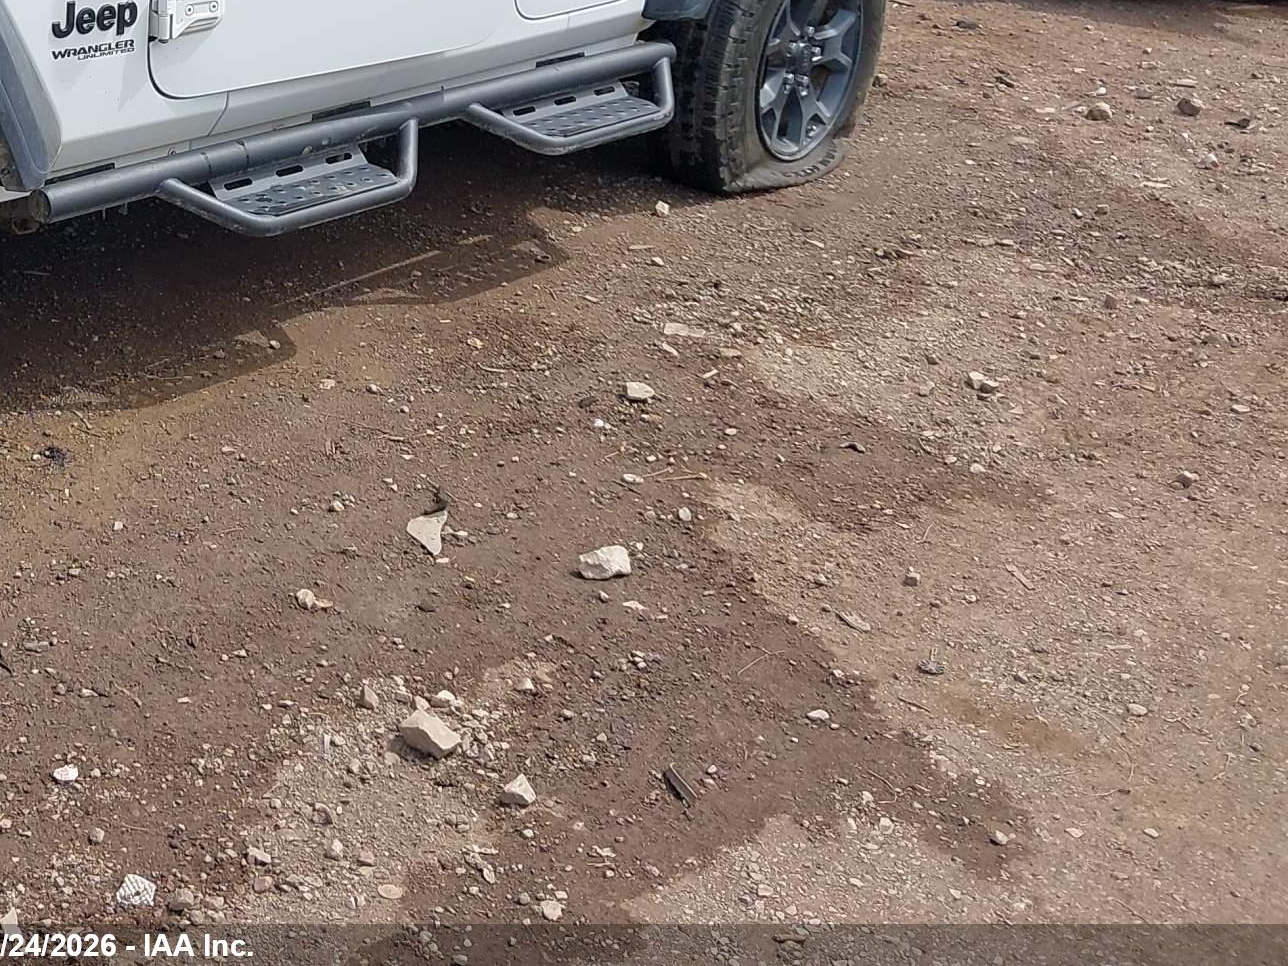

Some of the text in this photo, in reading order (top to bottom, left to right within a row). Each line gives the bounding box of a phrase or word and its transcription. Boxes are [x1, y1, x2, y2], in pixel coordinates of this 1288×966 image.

[51, 0, 138, 39] Jeep
[51, 39, 135, 60] WRANGLER
[77, 47, 135, 61] UNLIMITED
